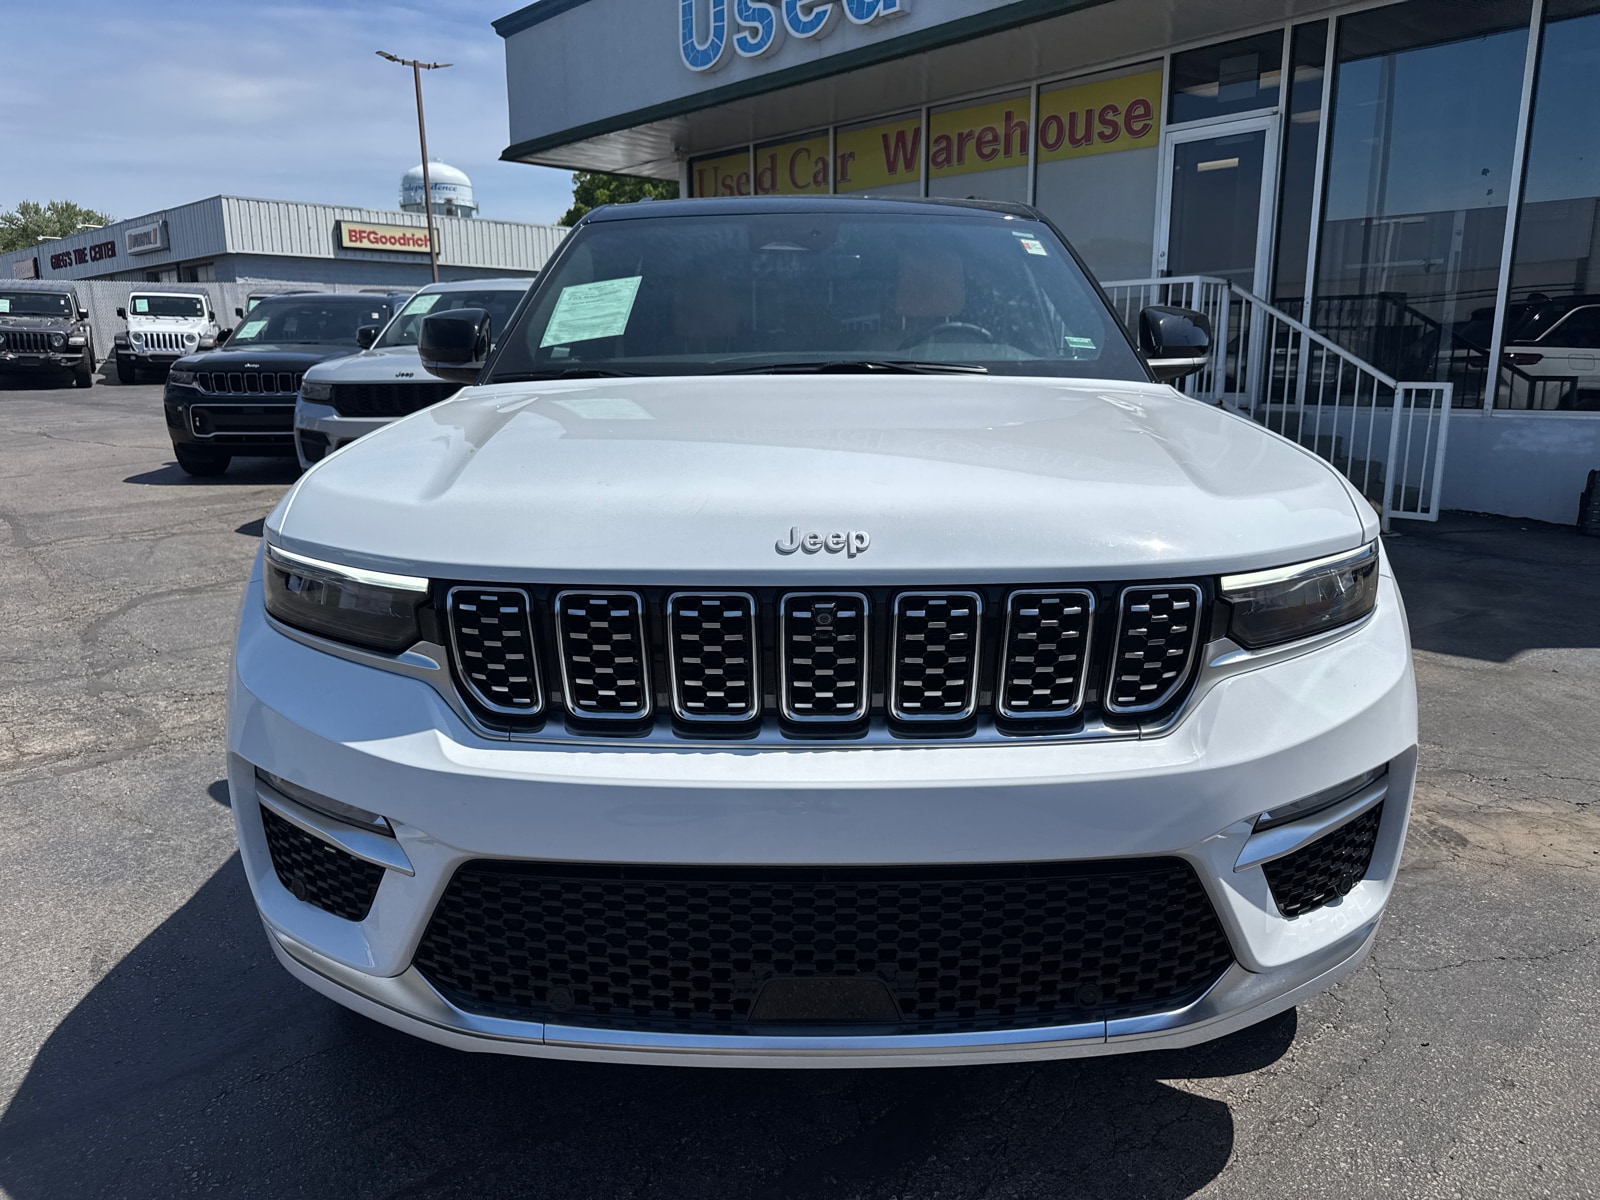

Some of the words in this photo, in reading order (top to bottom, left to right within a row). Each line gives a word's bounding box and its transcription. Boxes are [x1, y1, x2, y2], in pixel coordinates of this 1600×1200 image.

[679, 0, 900, 71] Use
[696, 153, 779, 197] Used
[789, 147, 855, 190] Car
[881, 98, 1154, 176] Warehouse
[72, 246, 88, 265] TIRE
[89, 240, 116, 262] CENTER
[775, 526, 870, 559] Jeep
